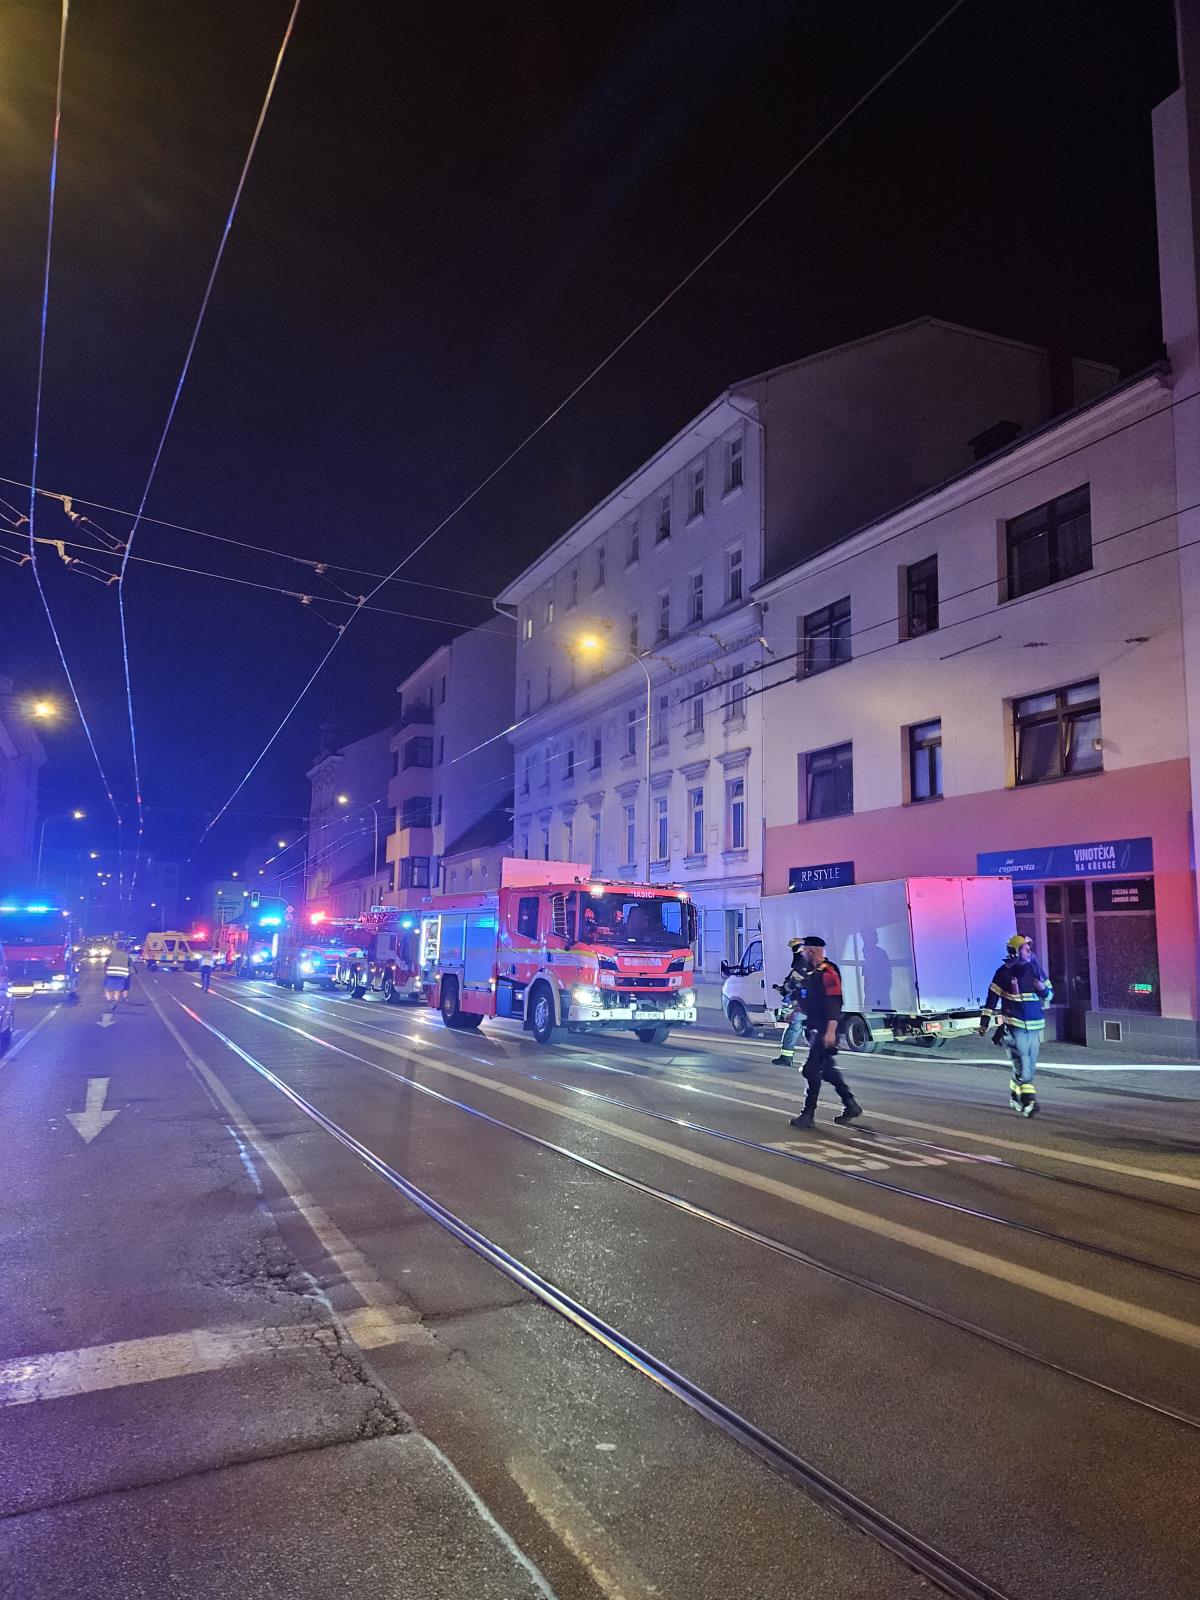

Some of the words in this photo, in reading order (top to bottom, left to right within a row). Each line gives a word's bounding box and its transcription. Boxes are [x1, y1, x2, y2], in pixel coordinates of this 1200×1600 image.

[1075, 862, 1085, 872] NA
[801, 870, 813, 882] RP
[813, 867, 841, 881] STYLE
